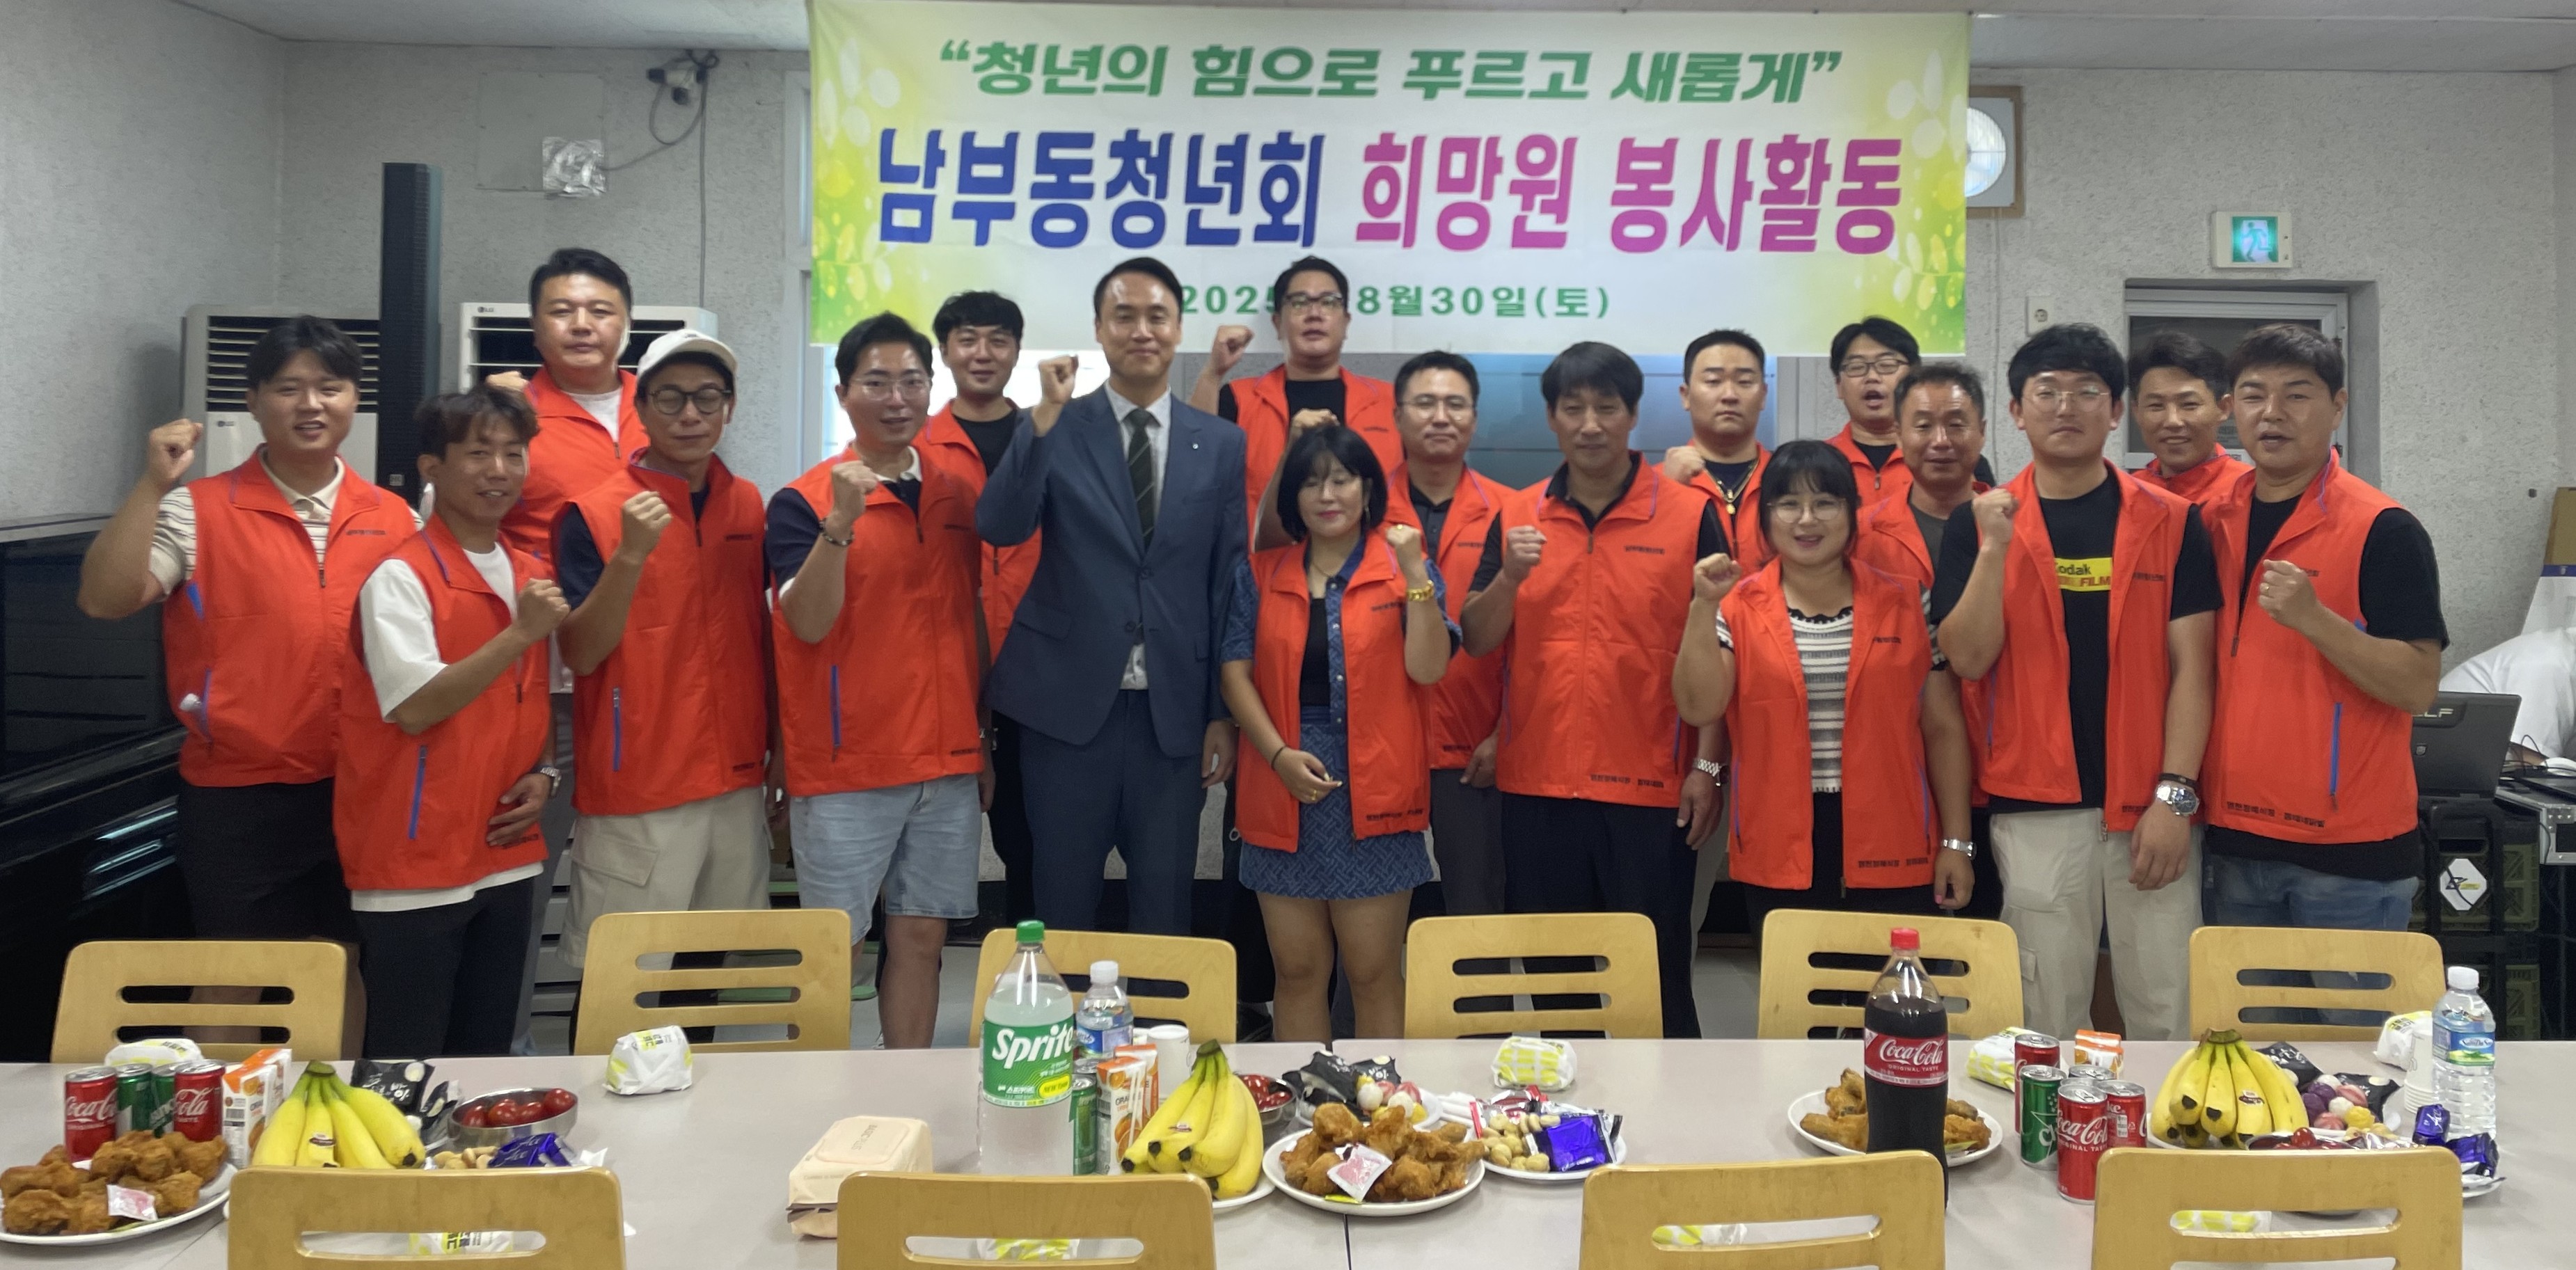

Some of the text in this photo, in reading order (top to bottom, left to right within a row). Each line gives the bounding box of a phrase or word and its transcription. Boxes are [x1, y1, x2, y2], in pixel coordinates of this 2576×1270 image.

[941, 40, 1842, 102] “청년의 힘으로 푸르고 새롭게”
[878, 128, 1902, 255] 남부동청년회 희망원 봉사활동
[2055, 563, 2092, 576] odak
[2412, 708, 2454, 718] LF
[991, 1022, 1073, 1070] Sprite
[1879, 1039, 1945, 1066] Coca-Cola
[1888, 1064, 1920, 1072] ORIGINAL
